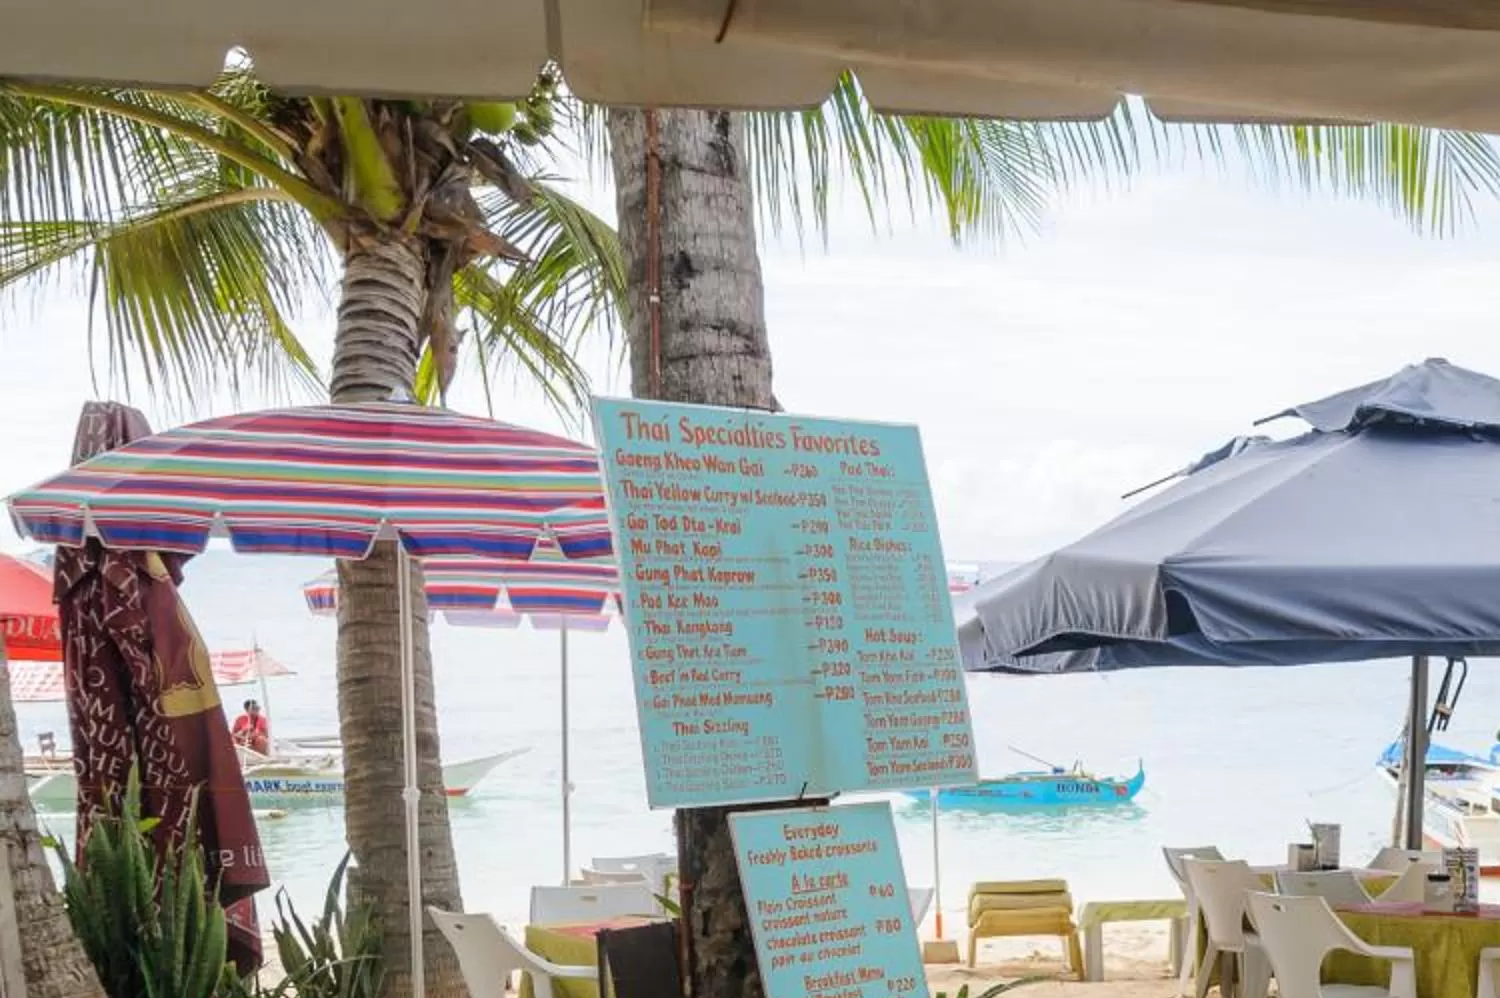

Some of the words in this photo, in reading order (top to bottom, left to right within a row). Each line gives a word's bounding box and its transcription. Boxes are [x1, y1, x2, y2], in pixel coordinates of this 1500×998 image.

[619, 411, 671, 443] Thai
[679, 416, 786, 450] Specialties
[789, 425, 881, 456] Favorites
[739, 455, 764, 477] Gai
[619, 479, 654, 501] Thai
[654, 480, 701, 502] Yellow
[702, 485, 738, 508] Curry
[626, 511, 650, 531] Gai
[652, 513, 678, 532] Tod
[629, 536, 652, 557] Mu
[655, 538, 686, 557] Phat
[672, 562, 705, 583] Phat
[643, 618, 672, 636] Thai
[863, 627, 887, 644] Hot
[650, 667, 676, 685] Beef
[672, 720, 701, 737] Thai
[703, 717, 750, 737] Sizzling
[783, 822, 840, 842] Everyday
[747, 847, 787, 866] Freshly
[789, 844, 823, 861] Baked
